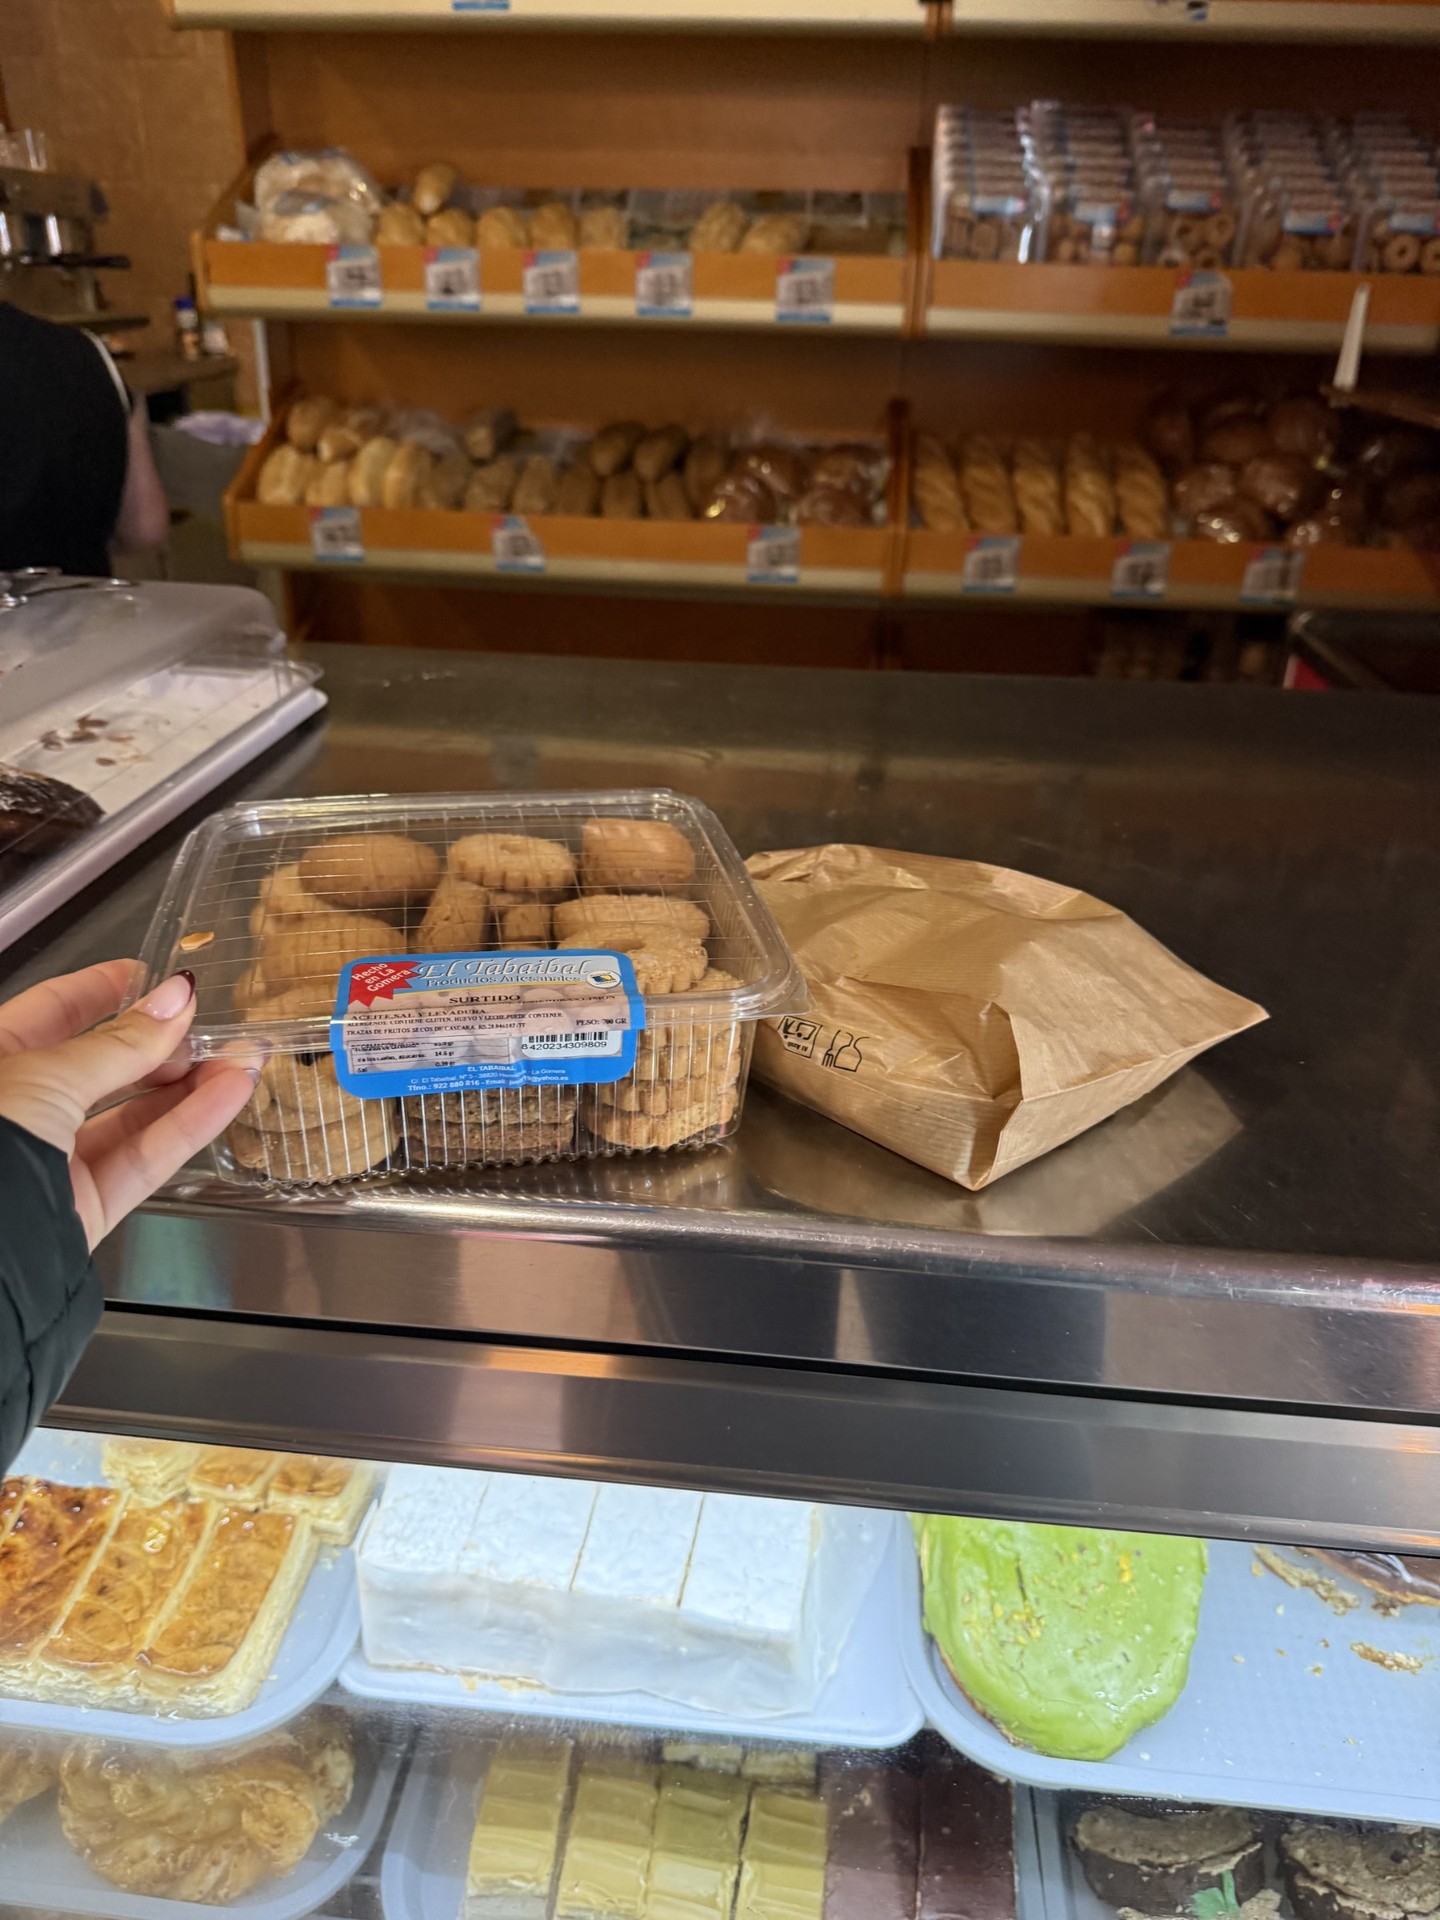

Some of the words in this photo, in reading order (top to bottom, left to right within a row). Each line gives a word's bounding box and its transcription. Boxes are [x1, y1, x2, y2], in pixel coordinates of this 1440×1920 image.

[351, 963, 388, 981] Hecho
[364, 976, 379, 985] en
[379, 968, 396, 977] La
[418, 960, 463, 980] El
[465, 957, 593, 977] Tabaibal
[366, 969, 412, 992] Gomera
[426, 976, 497, 988] Productos
[449, 994, 521, 1005] SURTIDO
[529, 1041, 608, 1051] 420234309809
